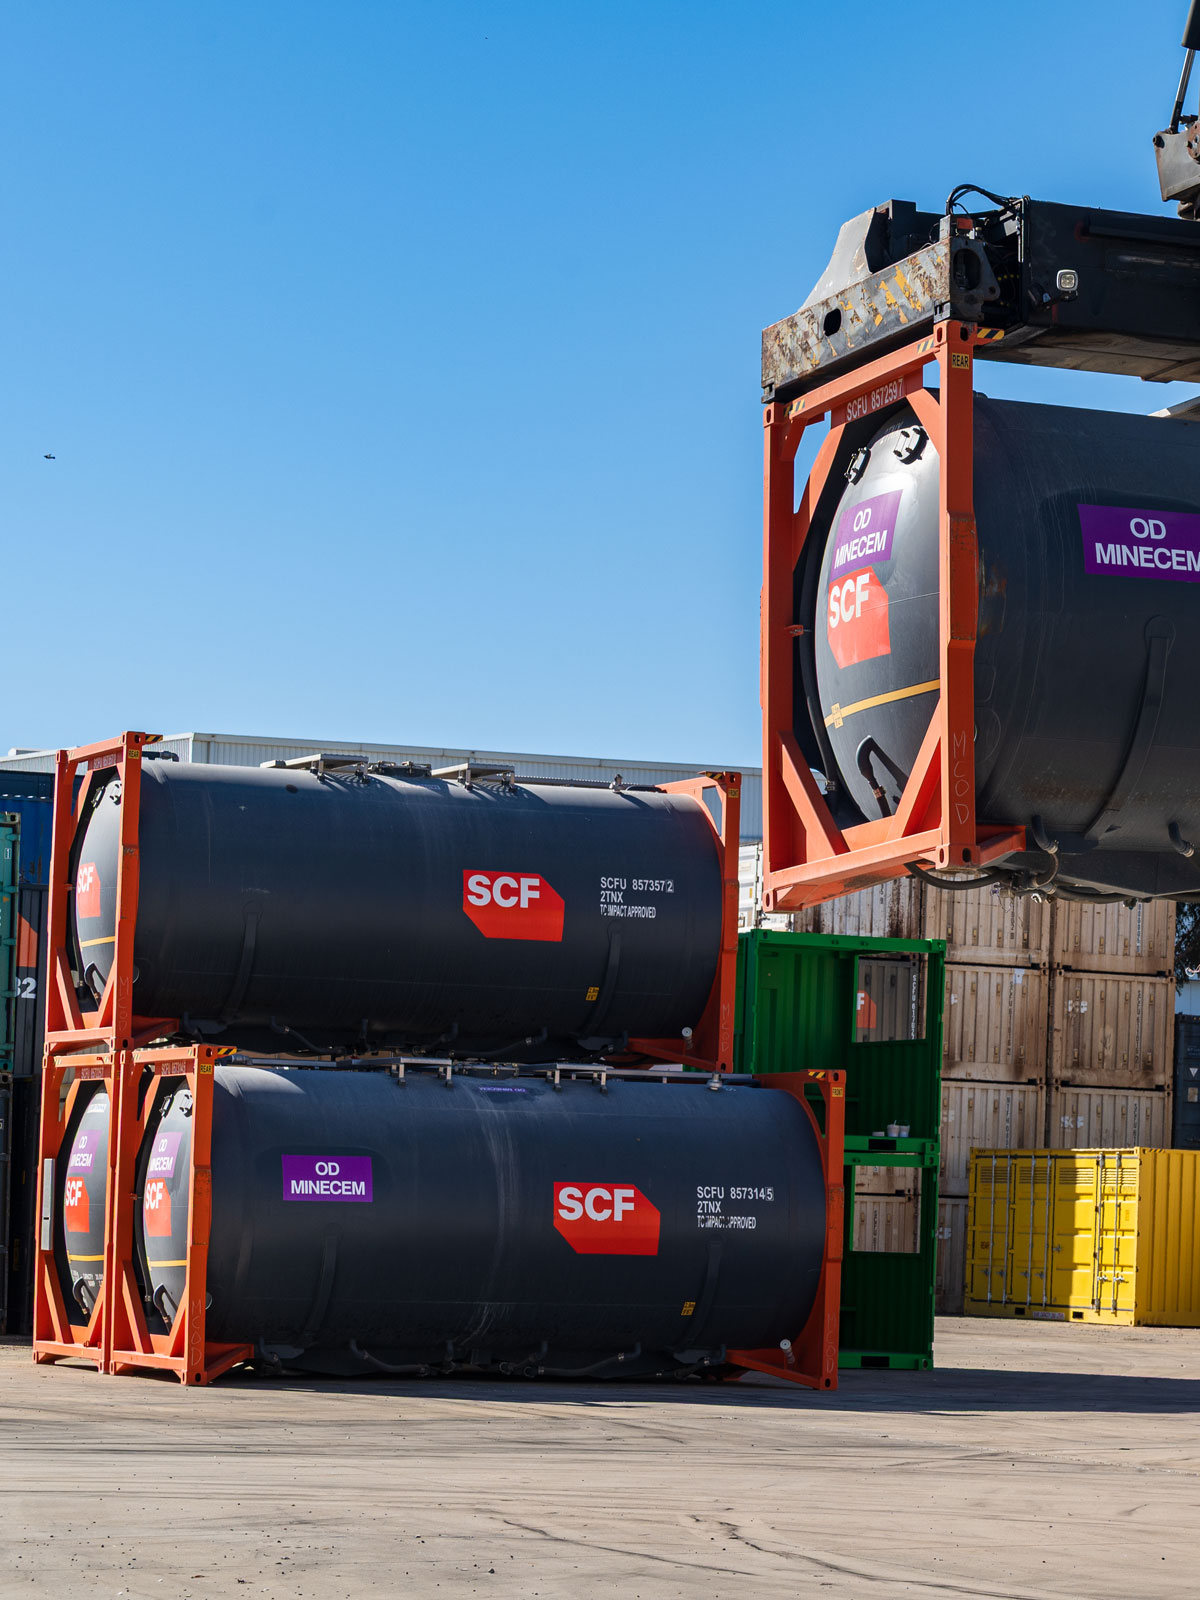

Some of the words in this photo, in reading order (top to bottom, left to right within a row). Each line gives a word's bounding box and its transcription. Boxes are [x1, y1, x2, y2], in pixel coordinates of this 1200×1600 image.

[953, 354, 970, 368] REAR
[846, 394, 868, 422] SCFU
[871, 378, 905, 412] 8572597
[853, 507, 872, 531] OD
[1129, 517, 1167, 540] OD
[834, 529, 887, 570] MINECEM
[828, 573, 871, 630] SCF
[77, 866, 95, 894] SCF
[600, 876, 627, 890] SCFU
[632, 878, 674, 894] 8573572
[466, 874, 541, 909] SCF
[600, 891, 624, 903] 2TNX
[627, 905, 657, 919] APPROVED
[200, 1063, 213, 1074] REAR
[78, 1136, 88, 1149] OD
[158, 1138, 168, 1153] OD
[314, 1162, 340, 1176] OD
[65, 1180, 83, 1207] SCF
[145, 1182, 164, 1210] SCF
[290, 1180, 366, 1196] MINECEM
[696, 1186, 725, 1199] SCFU
[730, 1187, 774, 1201] 8573145
[557, 1186, 635, 1222] SCF
[697, 1201, 722, 1213] 2TNX
[697, 1215, 705, 1227] TC
